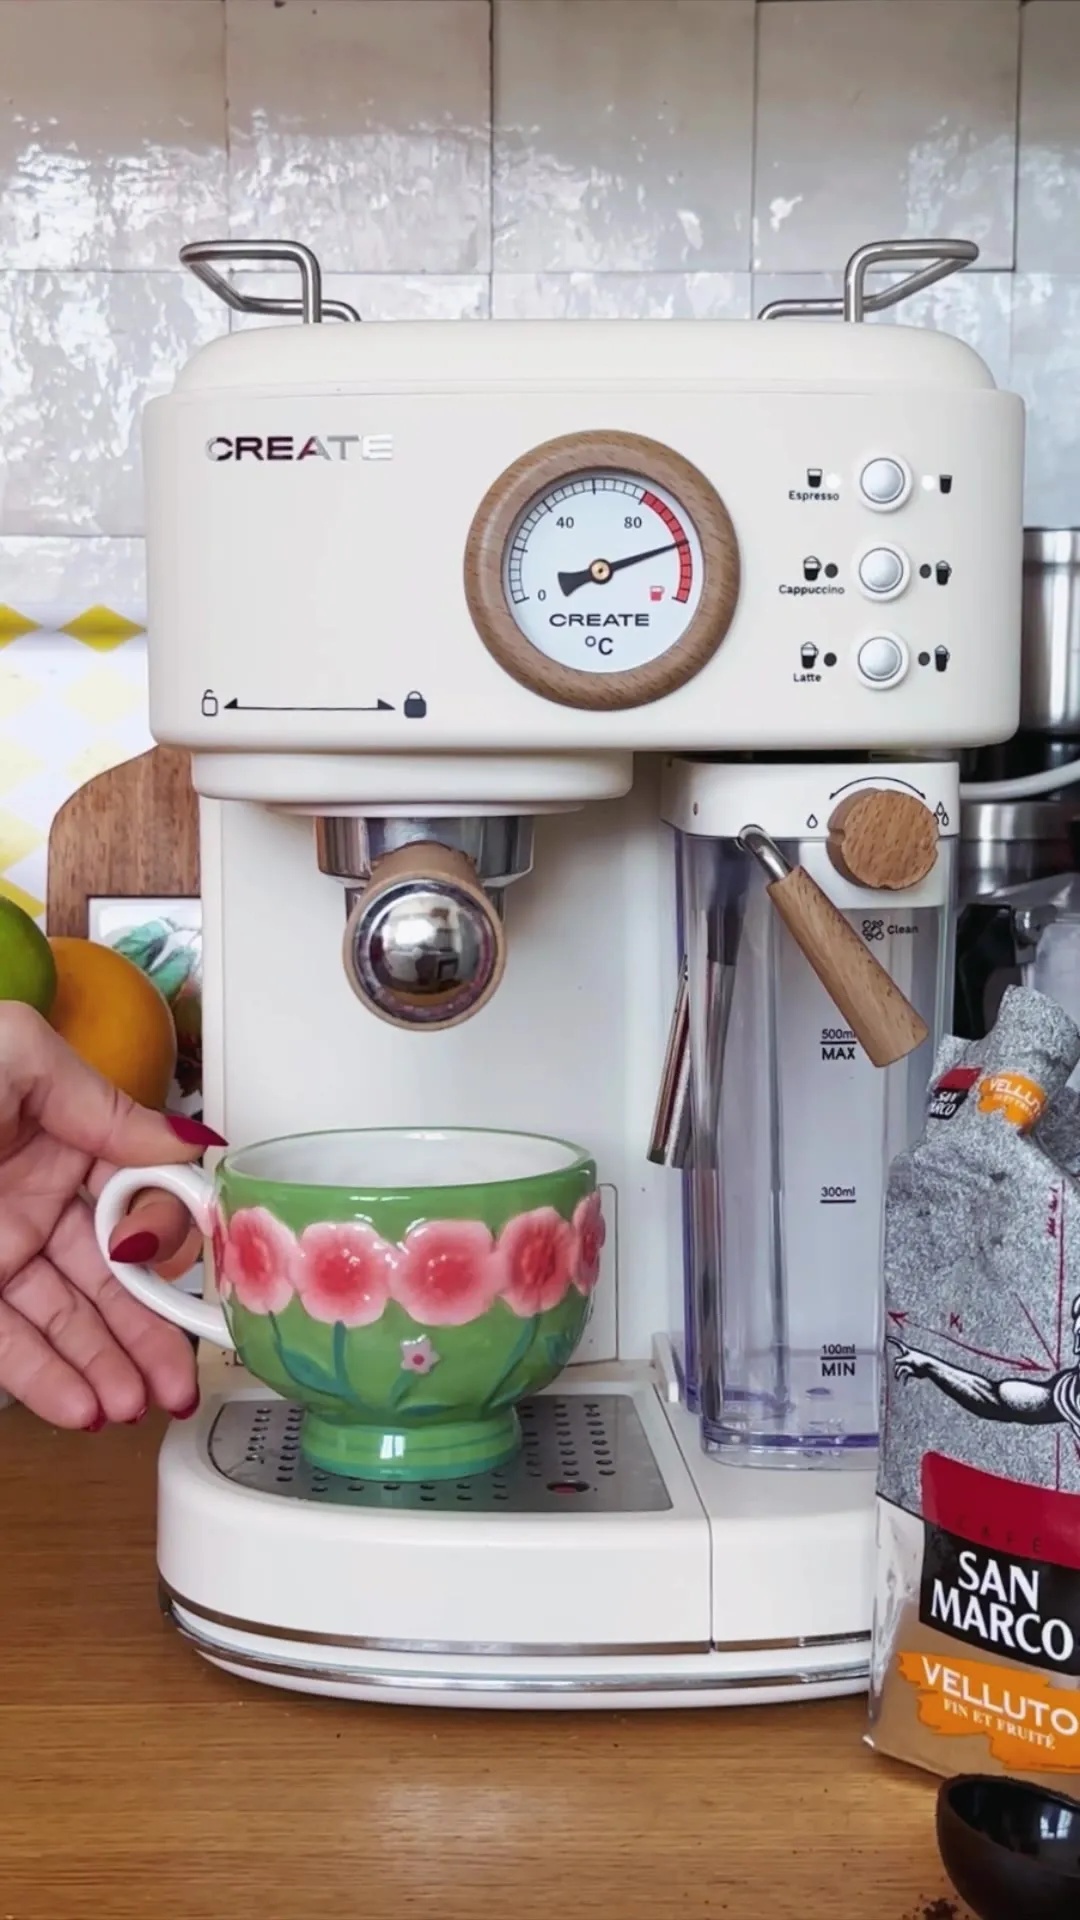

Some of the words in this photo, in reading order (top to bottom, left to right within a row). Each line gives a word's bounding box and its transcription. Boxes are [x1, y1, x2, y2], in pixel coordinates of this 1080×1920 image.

[205, 435, 393, 461] CREATE
[788, 489, 840, 502] Espresso
[556, 516, 575, 529] 40
[624, 516, 642, 529] 80
[537, 589, 547, 601] 0
[778, 584, 845, 596] Cappuccino
[549, 613, 650, 627] CREATE
[793, 673, 822, 683] Latte
[887, 924, 919, 935] Clean
[821, 1047, 855, 1060] MAX
[820, 1186, 856, 1198] 300ml
[821, 1343, 856, 1355] 100ml
[821, 1362, 855, 1377] MIN
[957, 1550, 1039, 1612] SAN
[930, 1578, 1074, 1661] MARCO
[921, 1655, 1079, 1736] VELLUTO
[943, 1698, 969, 1719] FIN
[972, 1709, 993, 1727] ET
